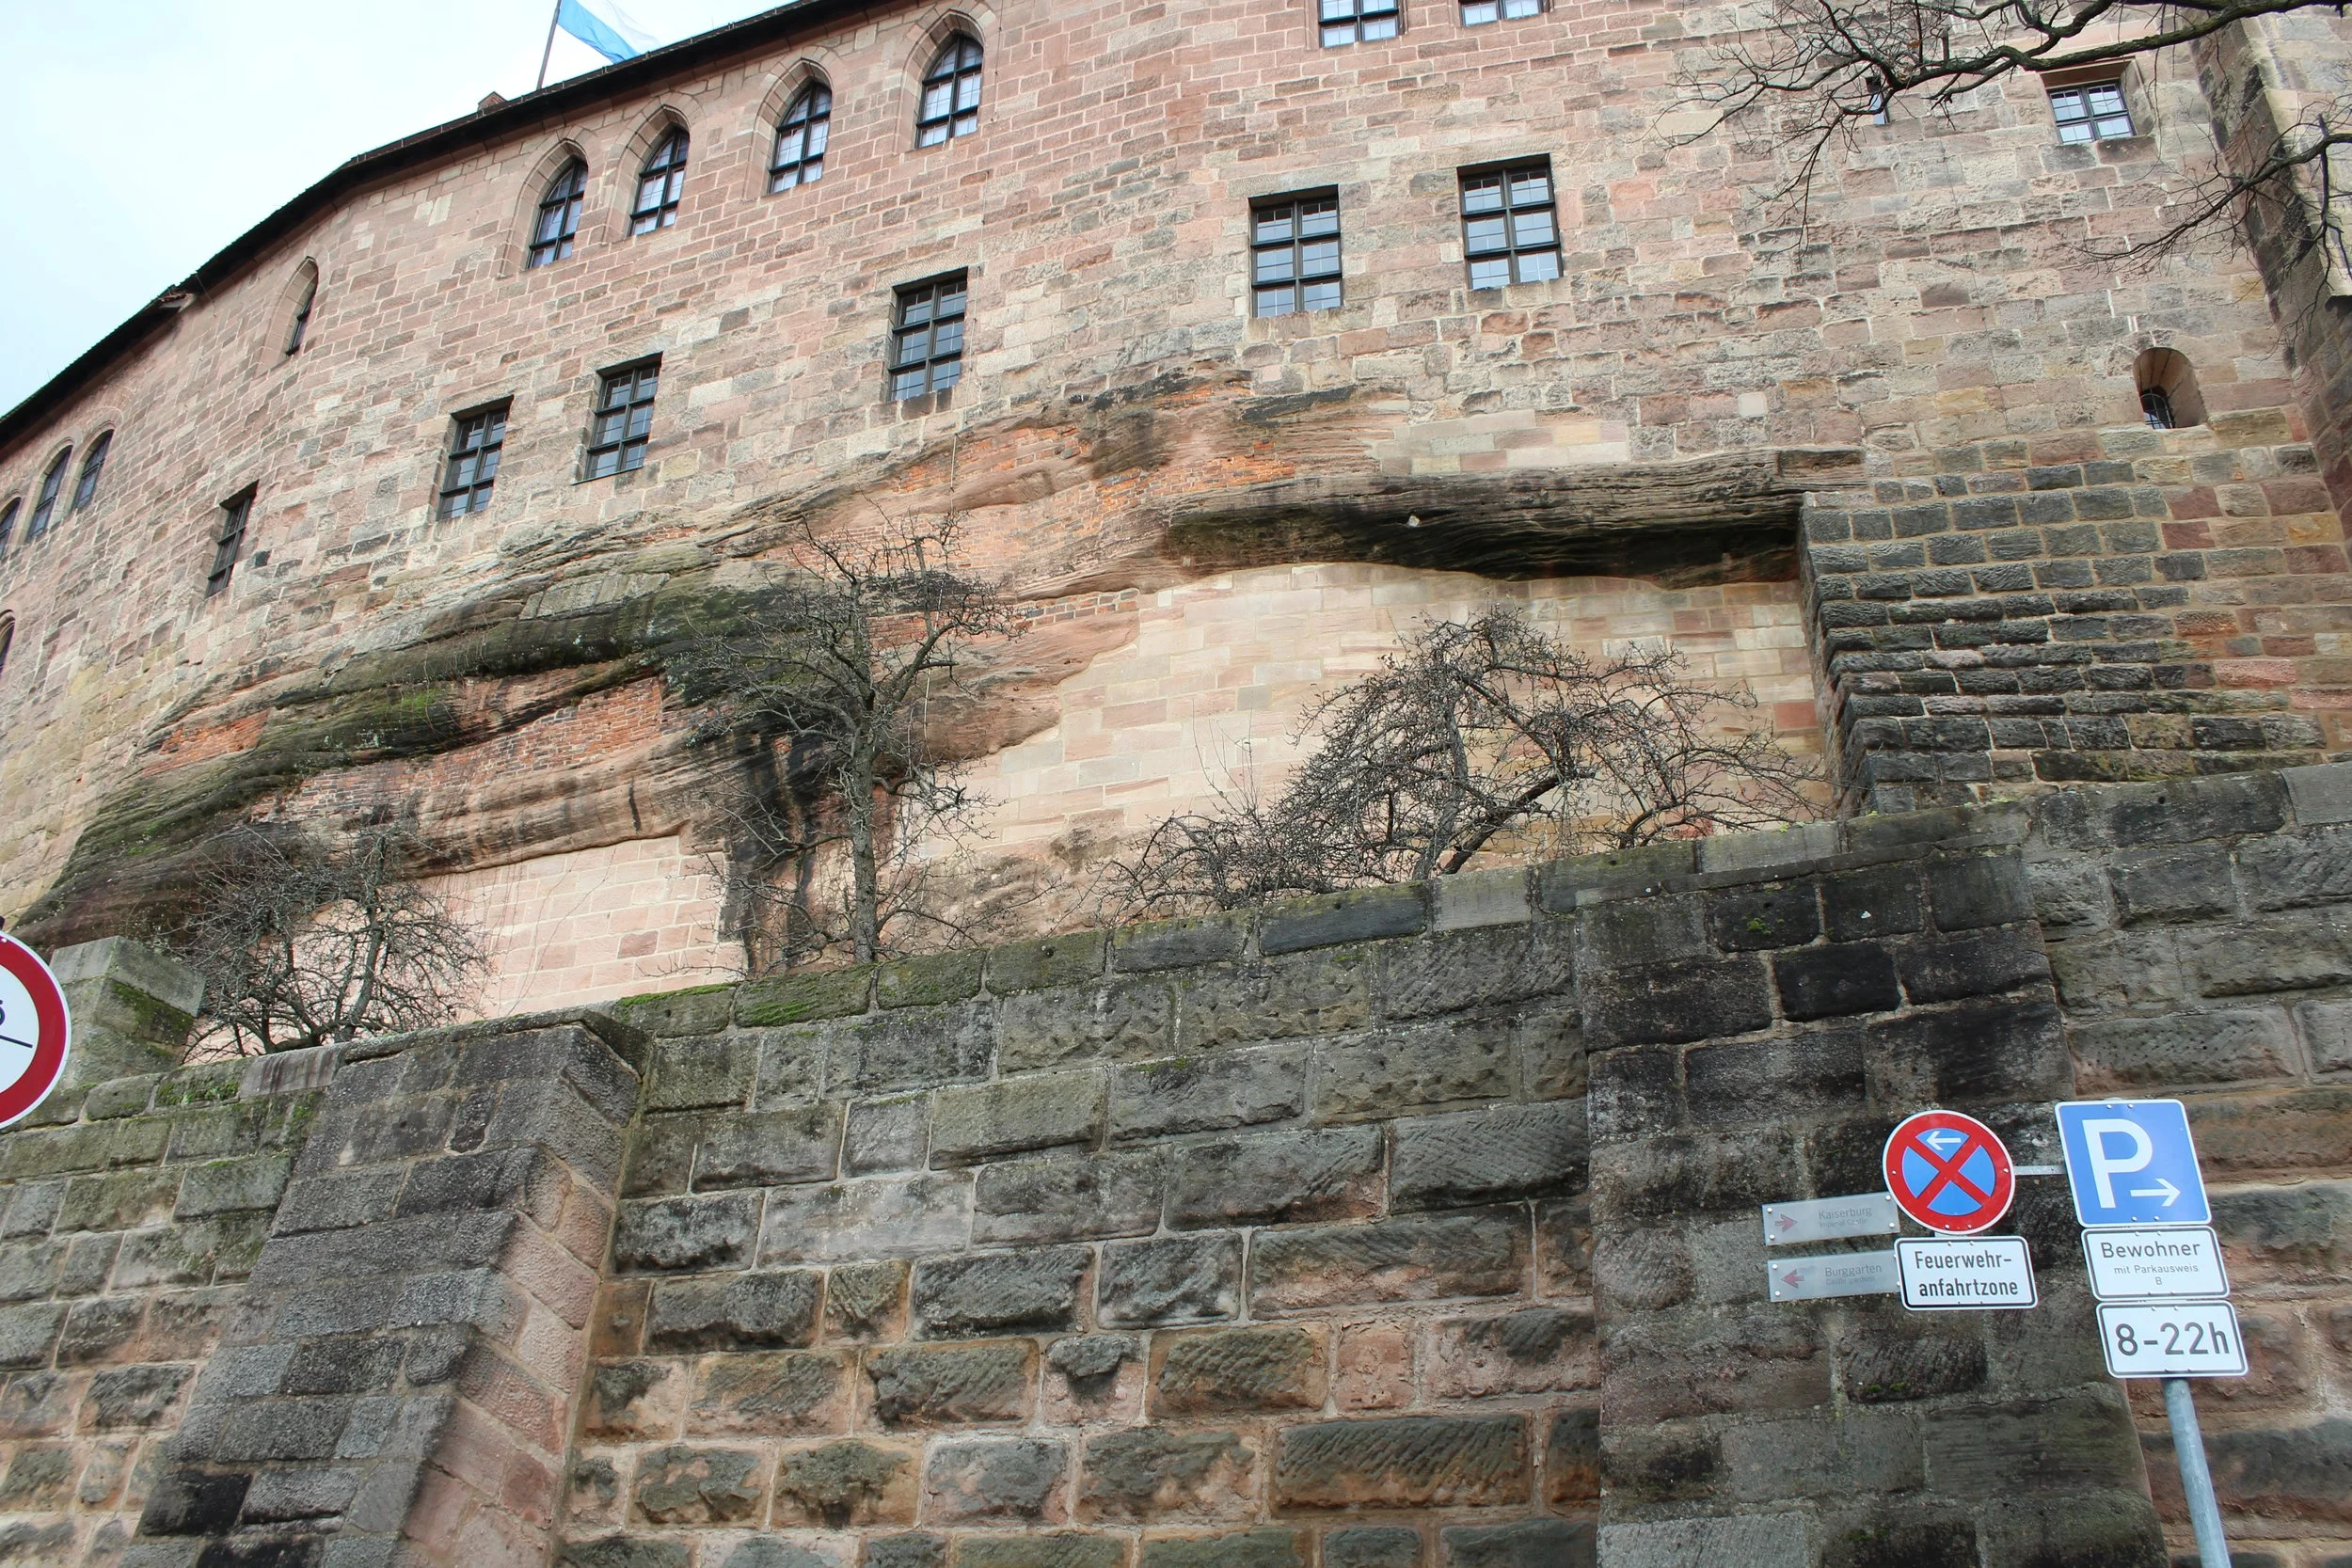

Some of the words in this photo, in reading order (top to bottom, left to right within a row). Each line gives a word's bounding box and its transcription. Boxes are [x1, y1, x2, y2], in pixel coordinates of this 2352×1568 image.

[2082, 1118, 2153, 1209] P
[1818, 1208, 1872, 1220] Kaiserburg
[2101, 1242, 2201, 1259] Bewohner
[1915, 1250, 2011, 1269] Feuerwehr-
[1825, 1264, 1882, 1277] Burggarten
[2114, 1266, 2131, 1275] mit
[2134, 1264, 2199, 1274] Parkausweis
[1919, 1278, 2018, 1296] anfahrtzone
[2155, 1276, 2163, 1285] B
